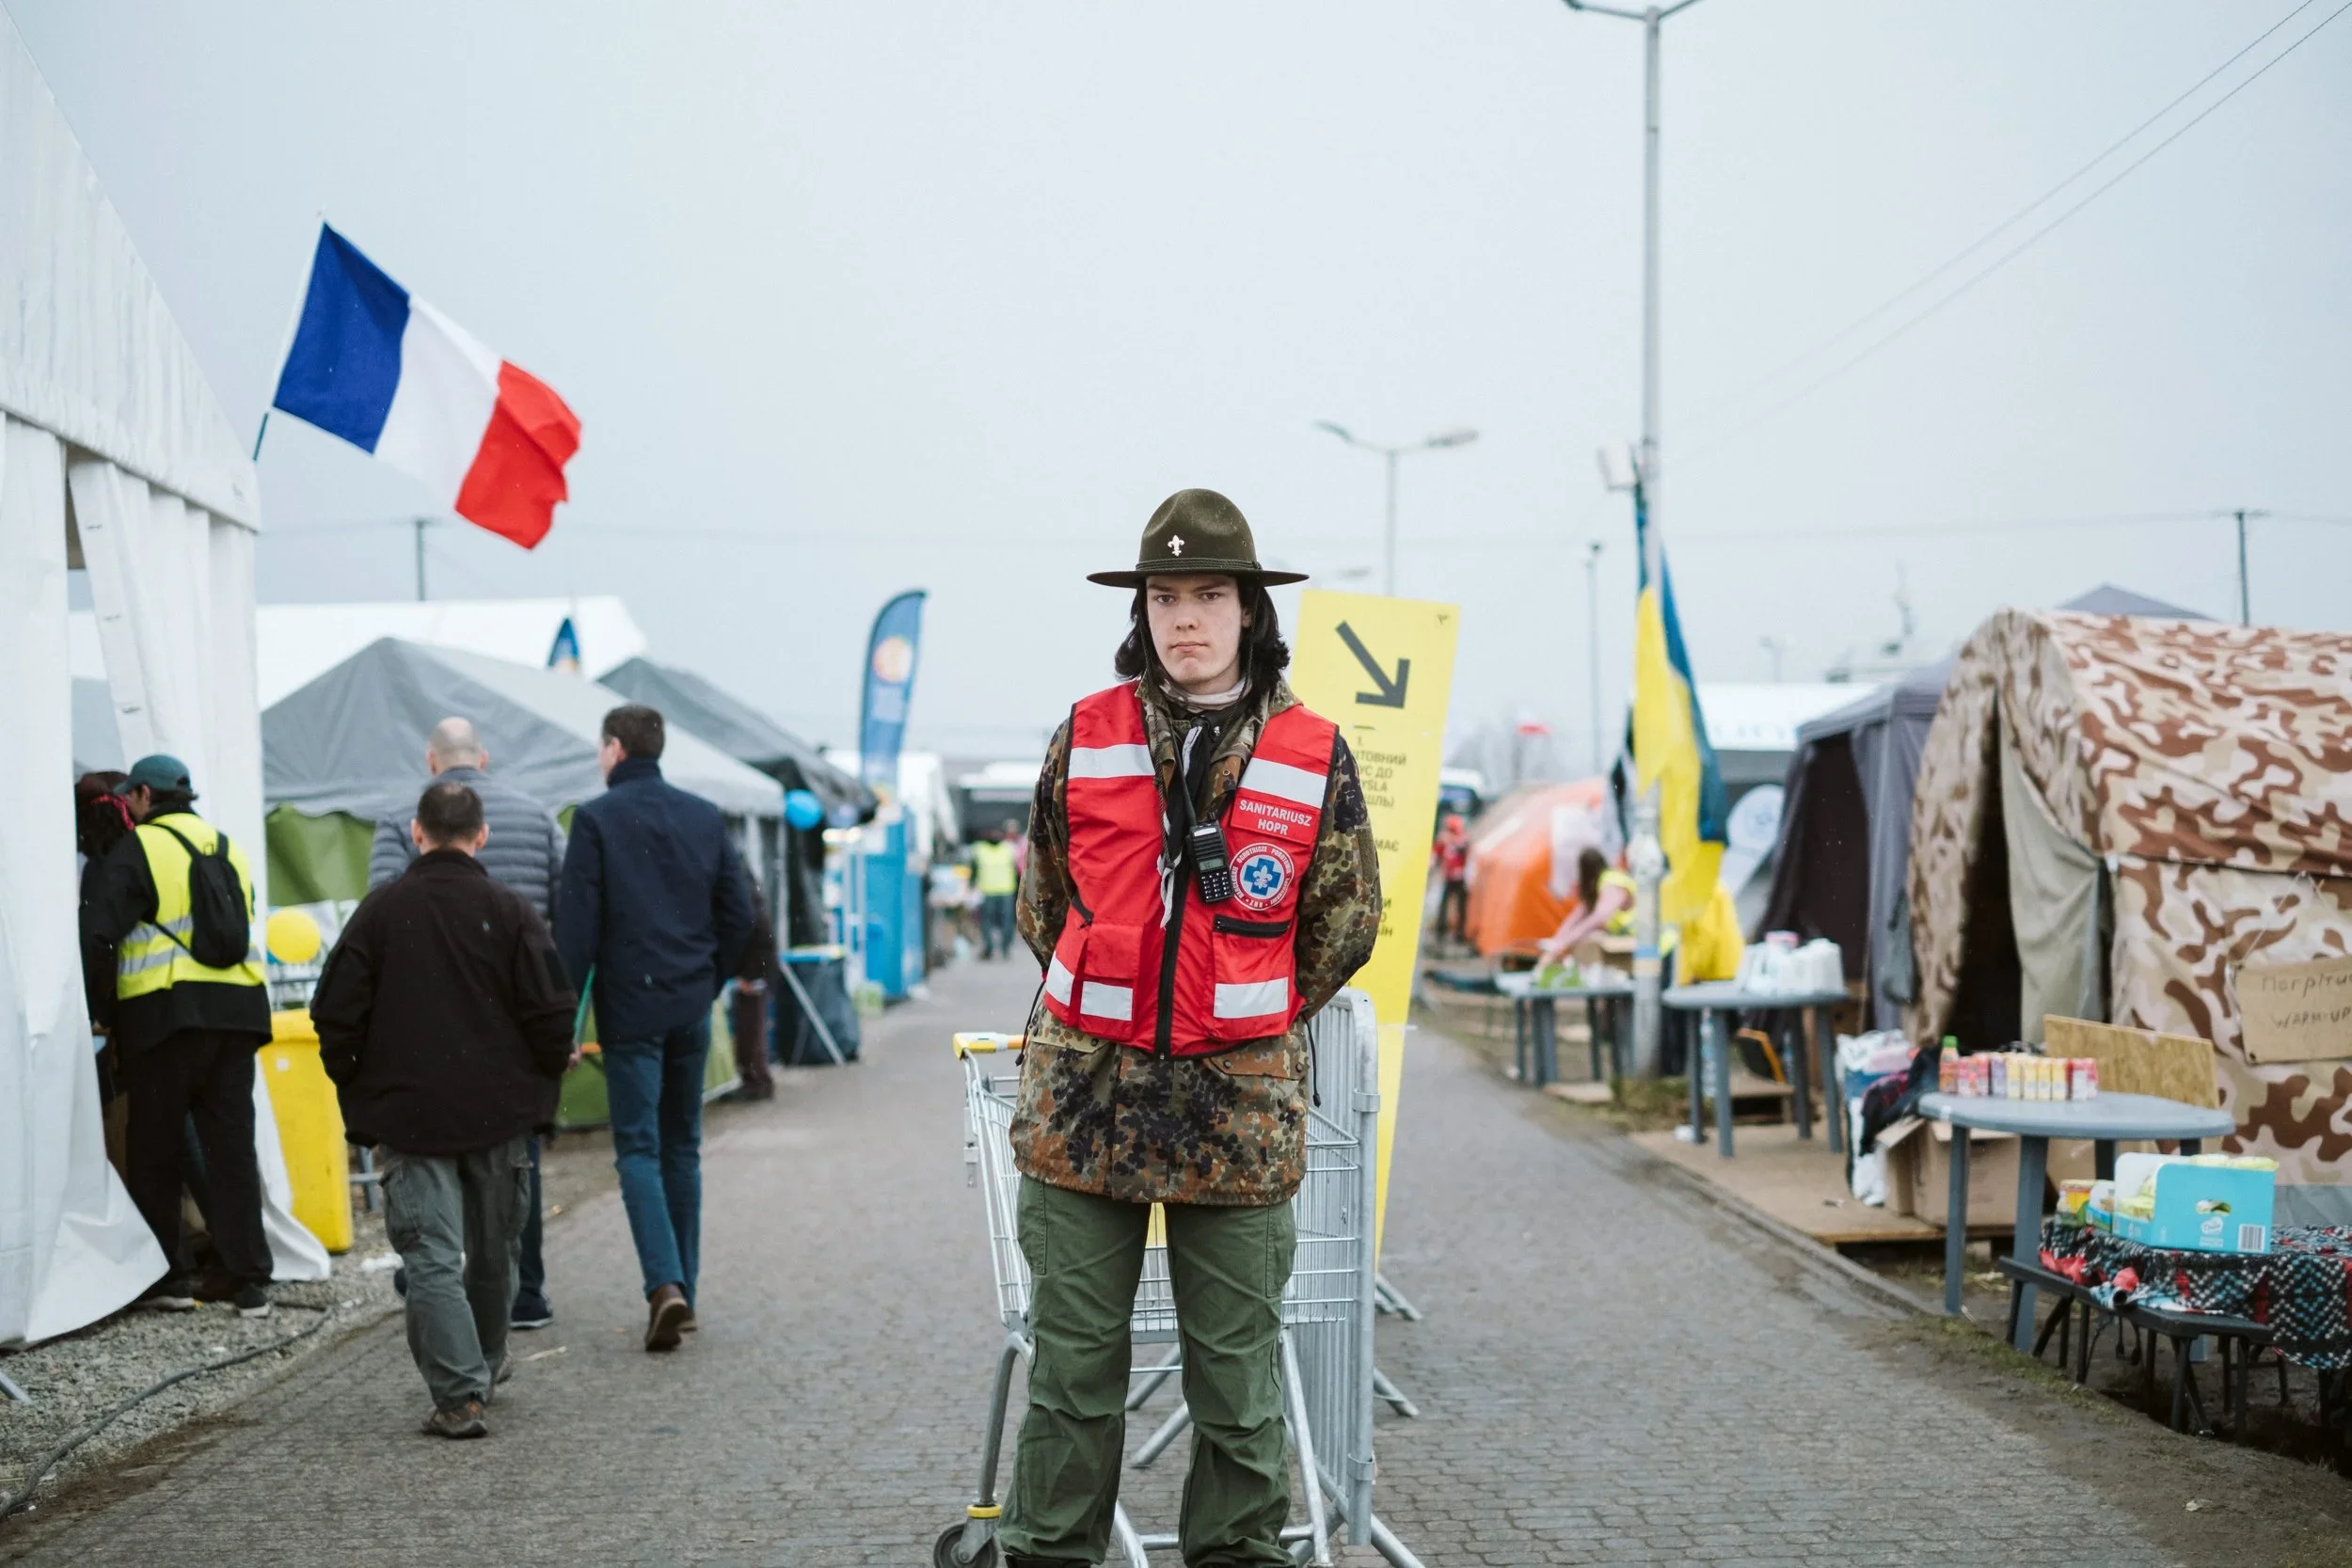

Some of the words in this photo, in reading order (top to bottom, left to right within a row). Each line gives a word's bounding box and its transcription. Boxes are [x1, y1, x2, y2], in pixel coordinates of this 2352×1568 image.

[1375, 767, 1393, 779] ДО
[1361, 779, 1388, 793] YSLA
[1239, 800, 1312, 827] SANITARIUSZ
[1257, 818, 1289, 835] HOPR
[1271, 847, 1292, 874] POGOTOWIE
